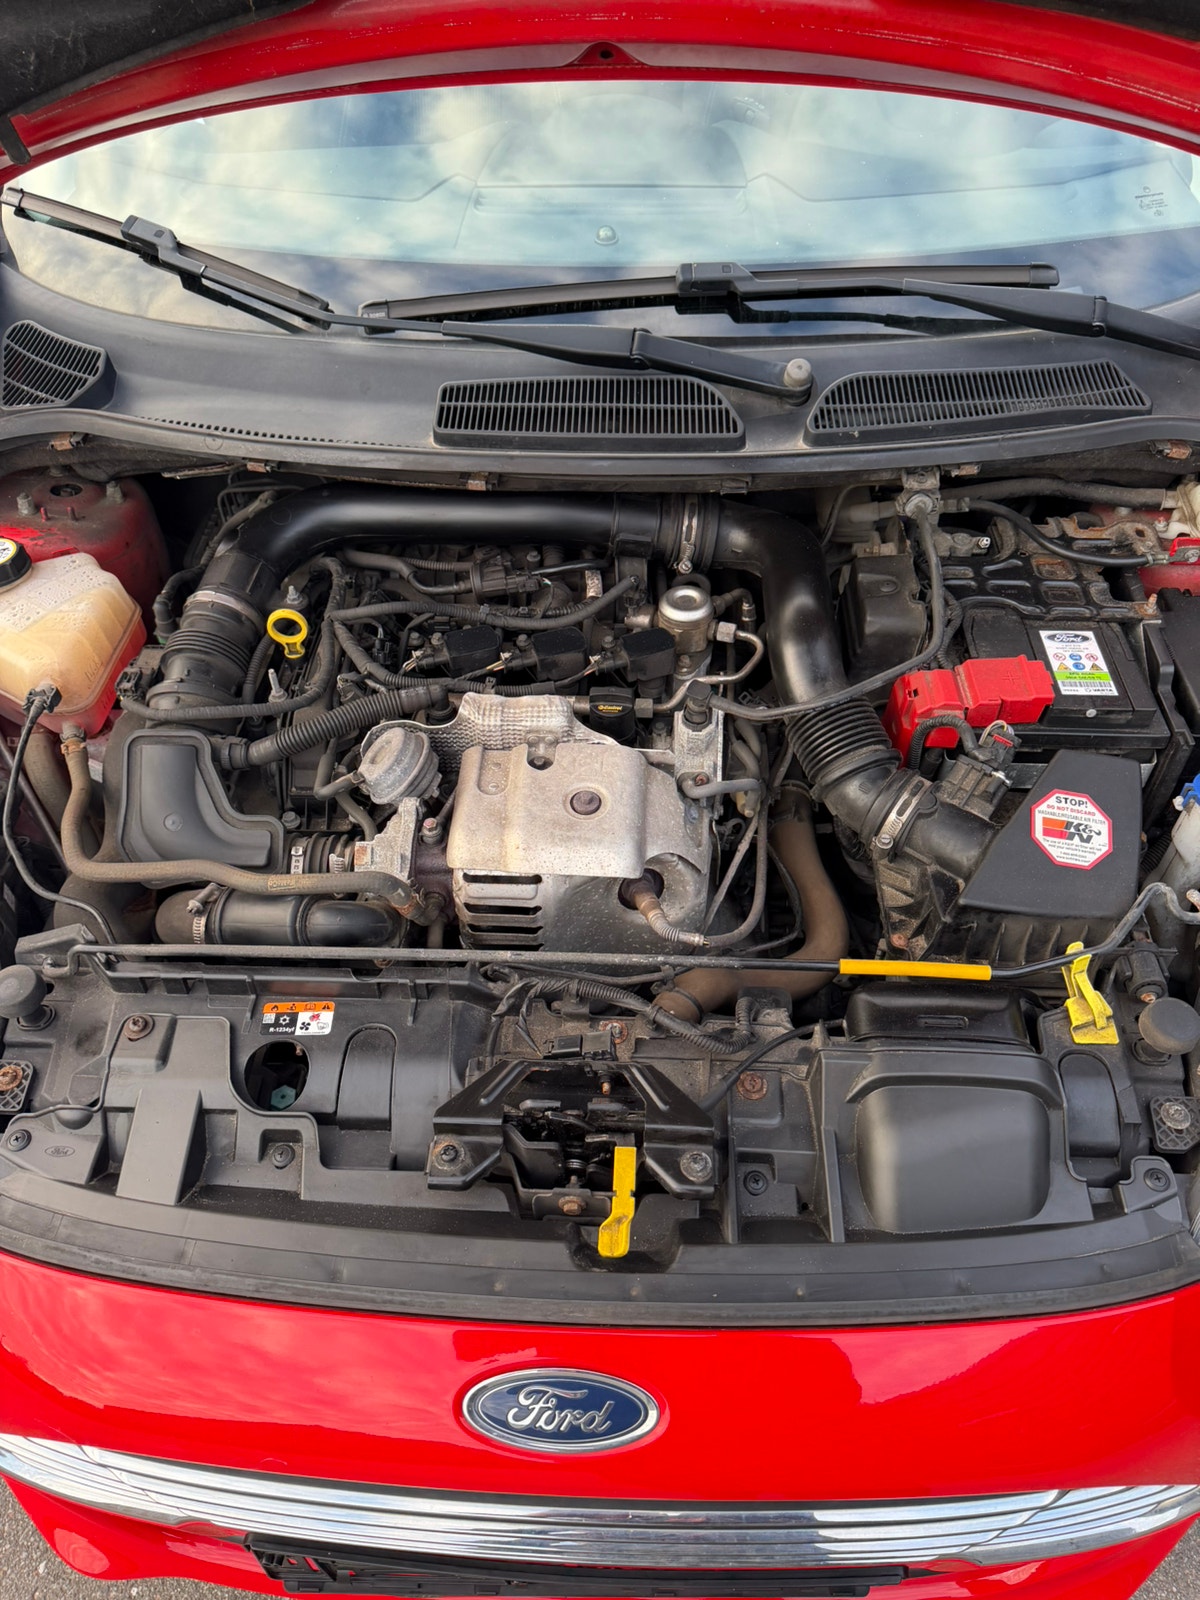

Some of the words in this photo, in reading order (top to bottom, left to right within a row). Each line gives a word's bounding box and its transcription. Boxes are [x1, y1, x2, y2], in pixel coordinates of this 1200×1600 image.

[1054, 633, 1082, 642] Ford
[1055, 796, 1088, 808] STOP!
[1070, 808, 1096, 816] DISCARD
[507, 1385, 615, 1433] Ford
